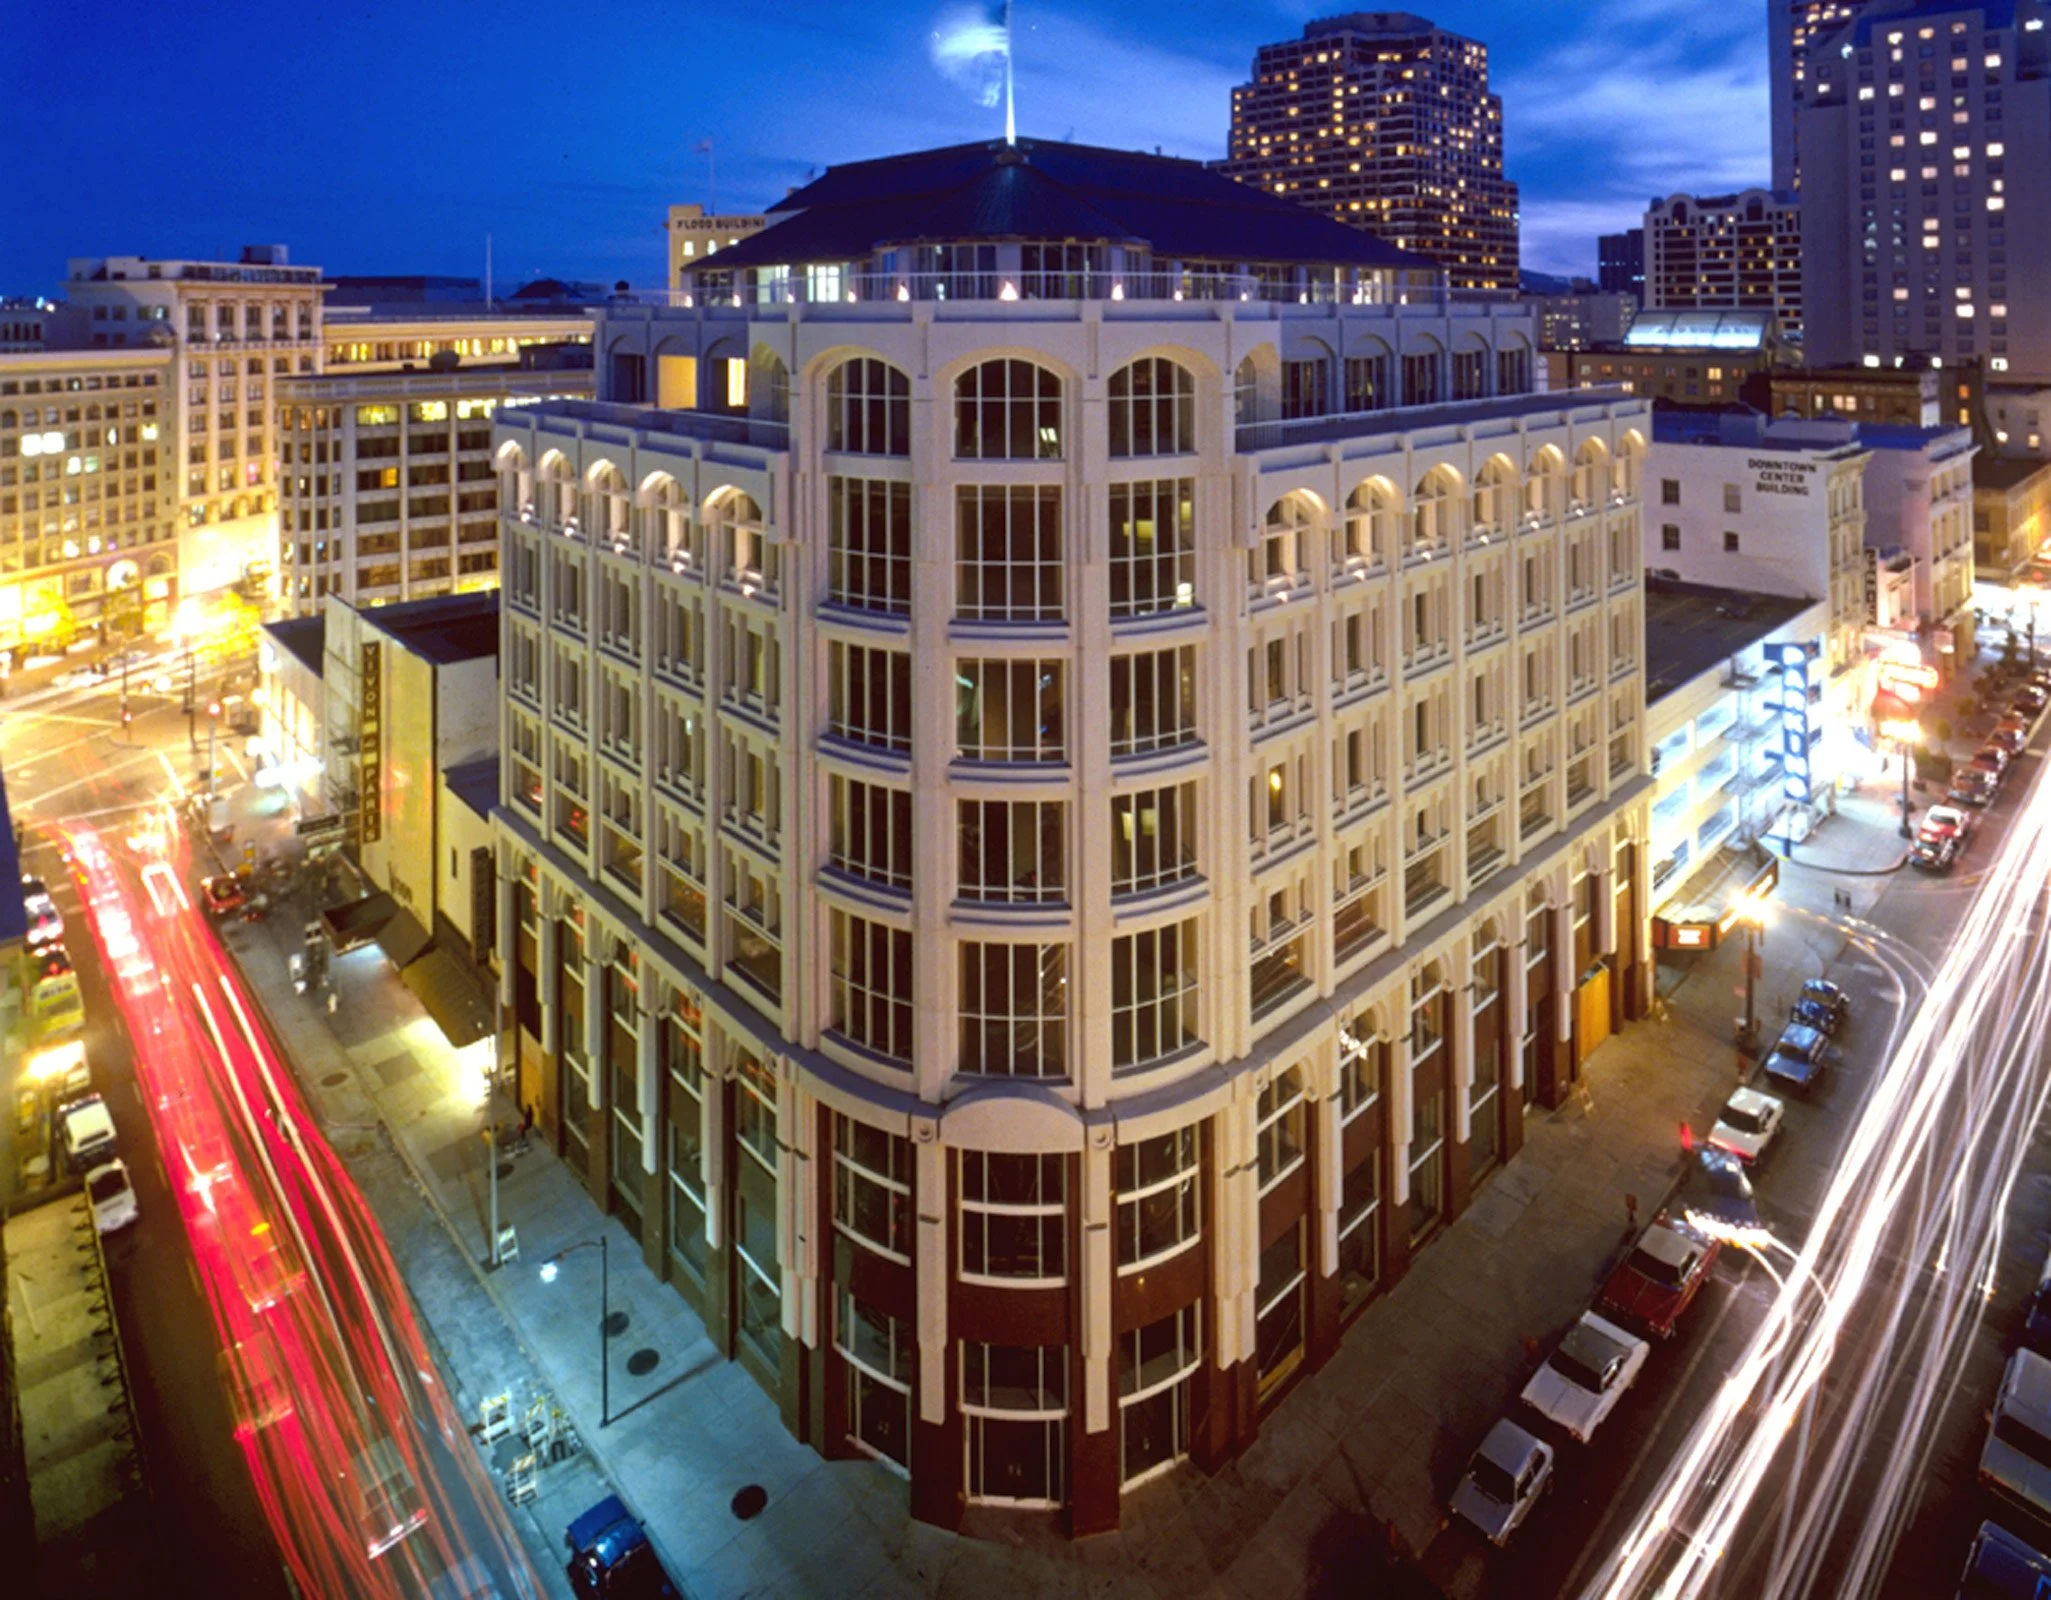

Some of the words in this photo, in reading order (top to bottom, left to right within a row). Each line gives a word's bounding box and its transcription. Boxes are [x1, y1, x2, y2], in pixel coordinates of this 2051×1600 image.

[677, 219, 713, 229] FLOOD
[1748, 458, 1817, 472] DOWNTOWN
[1760, 470, 1805, 483] CENTER
[1755, 481, 1809, 496] BUILDING
[365, 645, 378, 717] VIVON
[1783, 645, 1808, 798] PARKING
[365, 767, 378, 840] PARIS
